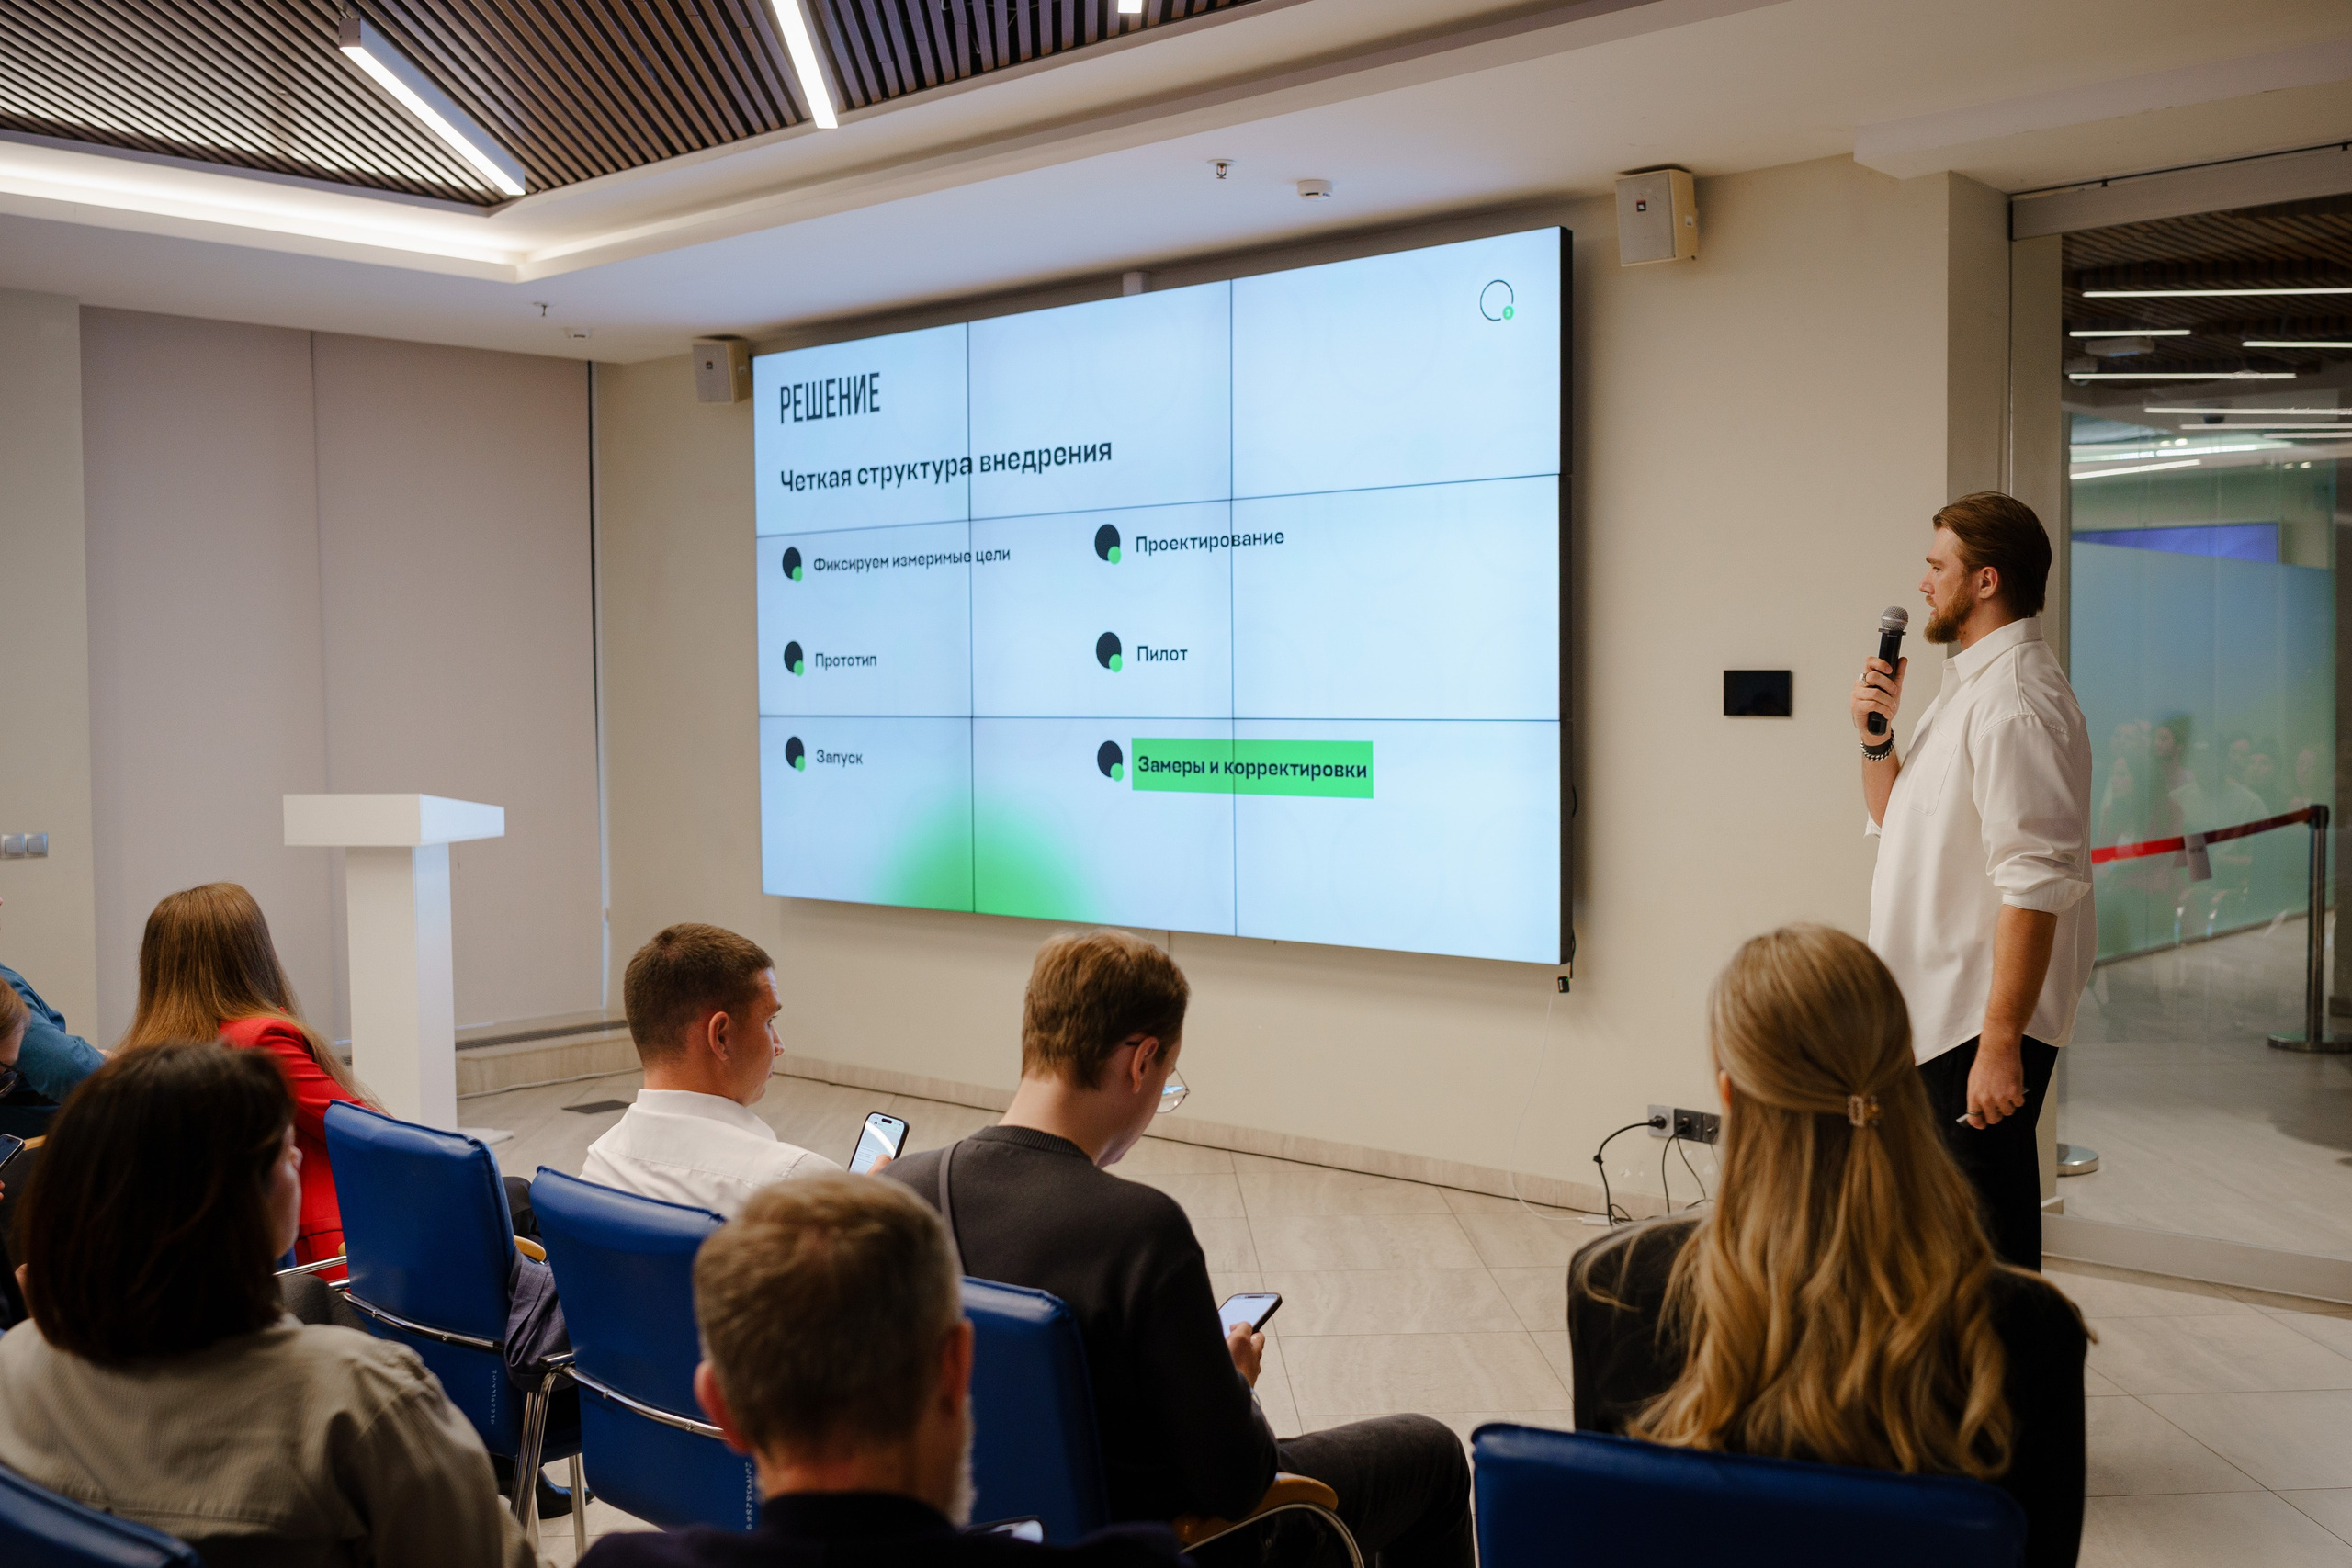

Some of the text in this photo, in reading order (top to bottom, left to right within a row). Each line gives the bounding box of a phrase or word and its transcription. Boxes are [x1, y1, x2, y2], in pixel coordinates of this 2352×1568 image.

[780, 372, 880, 424] РЕШЕНИЕ
[780, 442, 1112, 492] Четкая структура внедрения
[1136, 529, 1284, 557] Проектирование
[813, 549, 1011, 573] Фиксируем измеримые цели
[815, 652, 877, 671] Прототип
[1137, 645, 1188, 662] Пилот
[816, 749, 863, 768] Запуск
[1138, 755, 1367, 782] Замеры и корректировки
